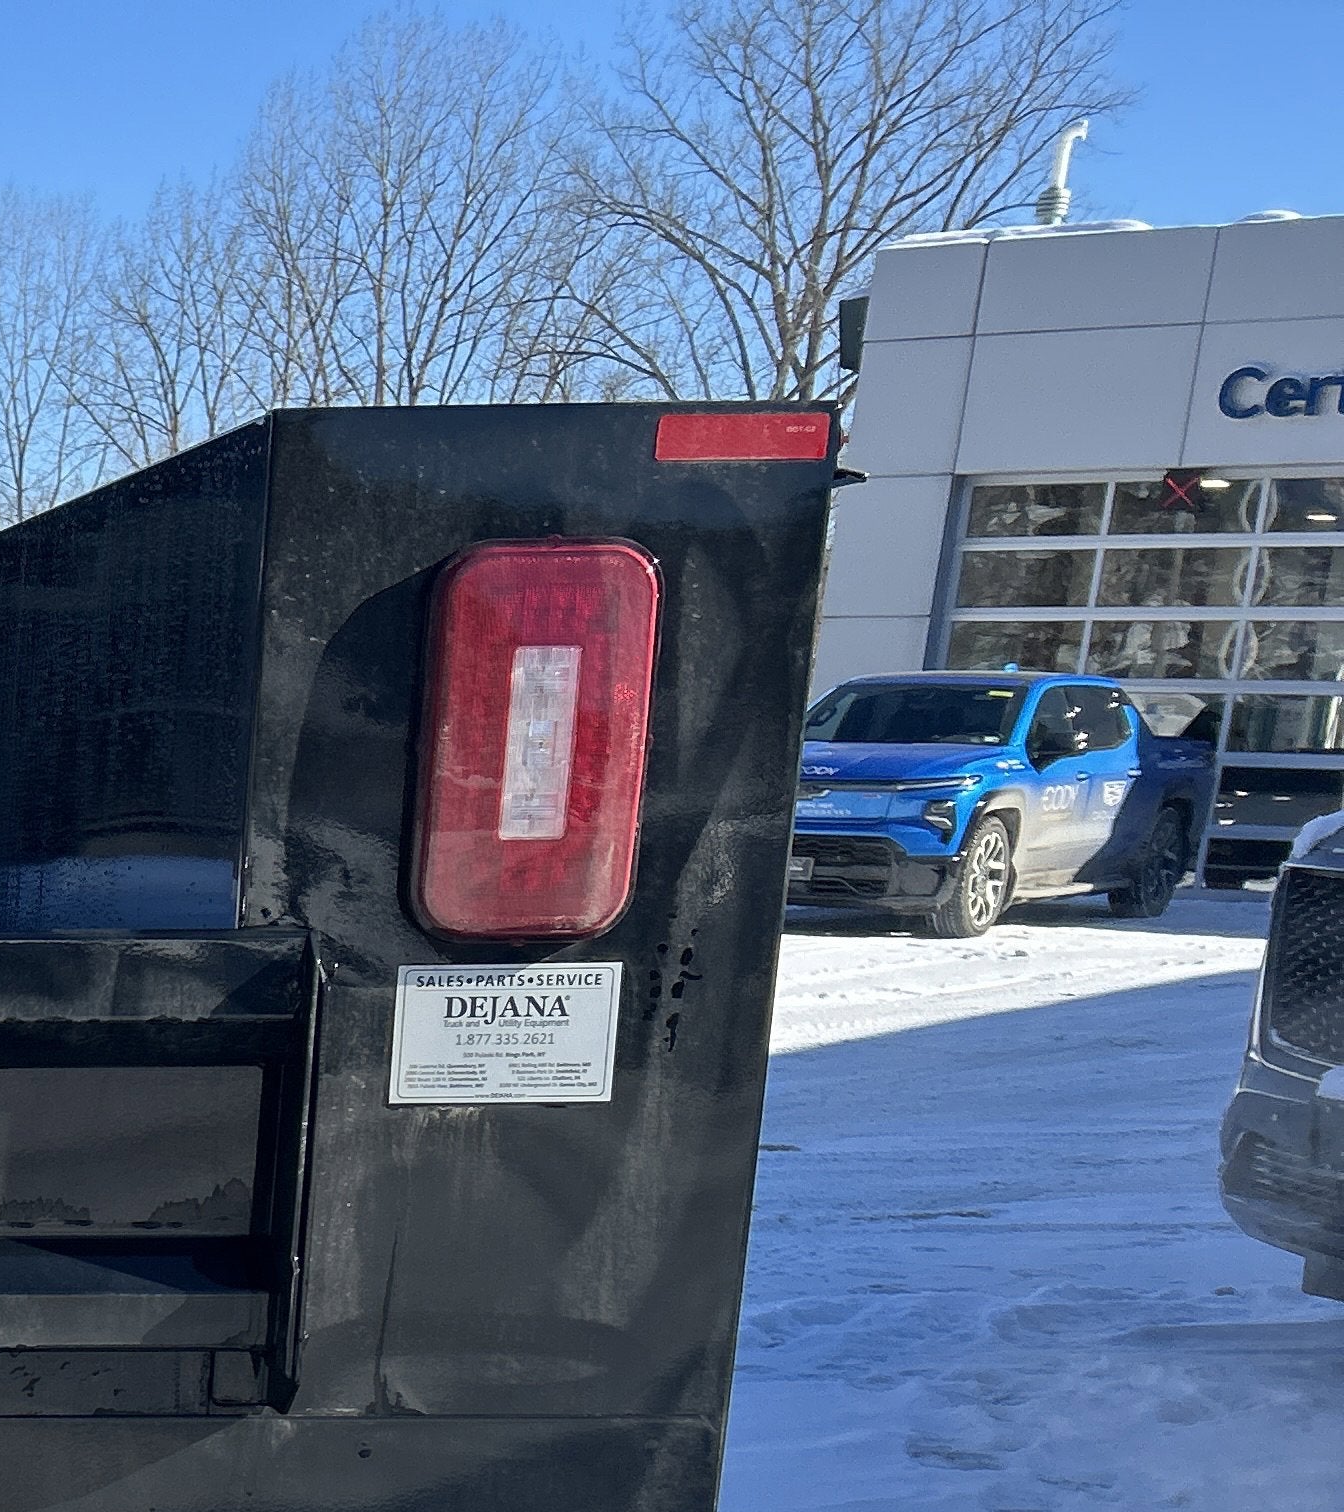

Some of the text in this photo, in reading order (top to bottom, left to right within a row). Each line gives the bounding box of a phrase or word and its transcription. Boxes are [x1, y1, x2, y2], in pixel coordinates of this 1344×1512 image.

[1218, 366, 1344, 419] Cer
[416, 973, 603, 987] SALES PARTS SERVICE
[443, 995, 570, 1025] DEJANA
